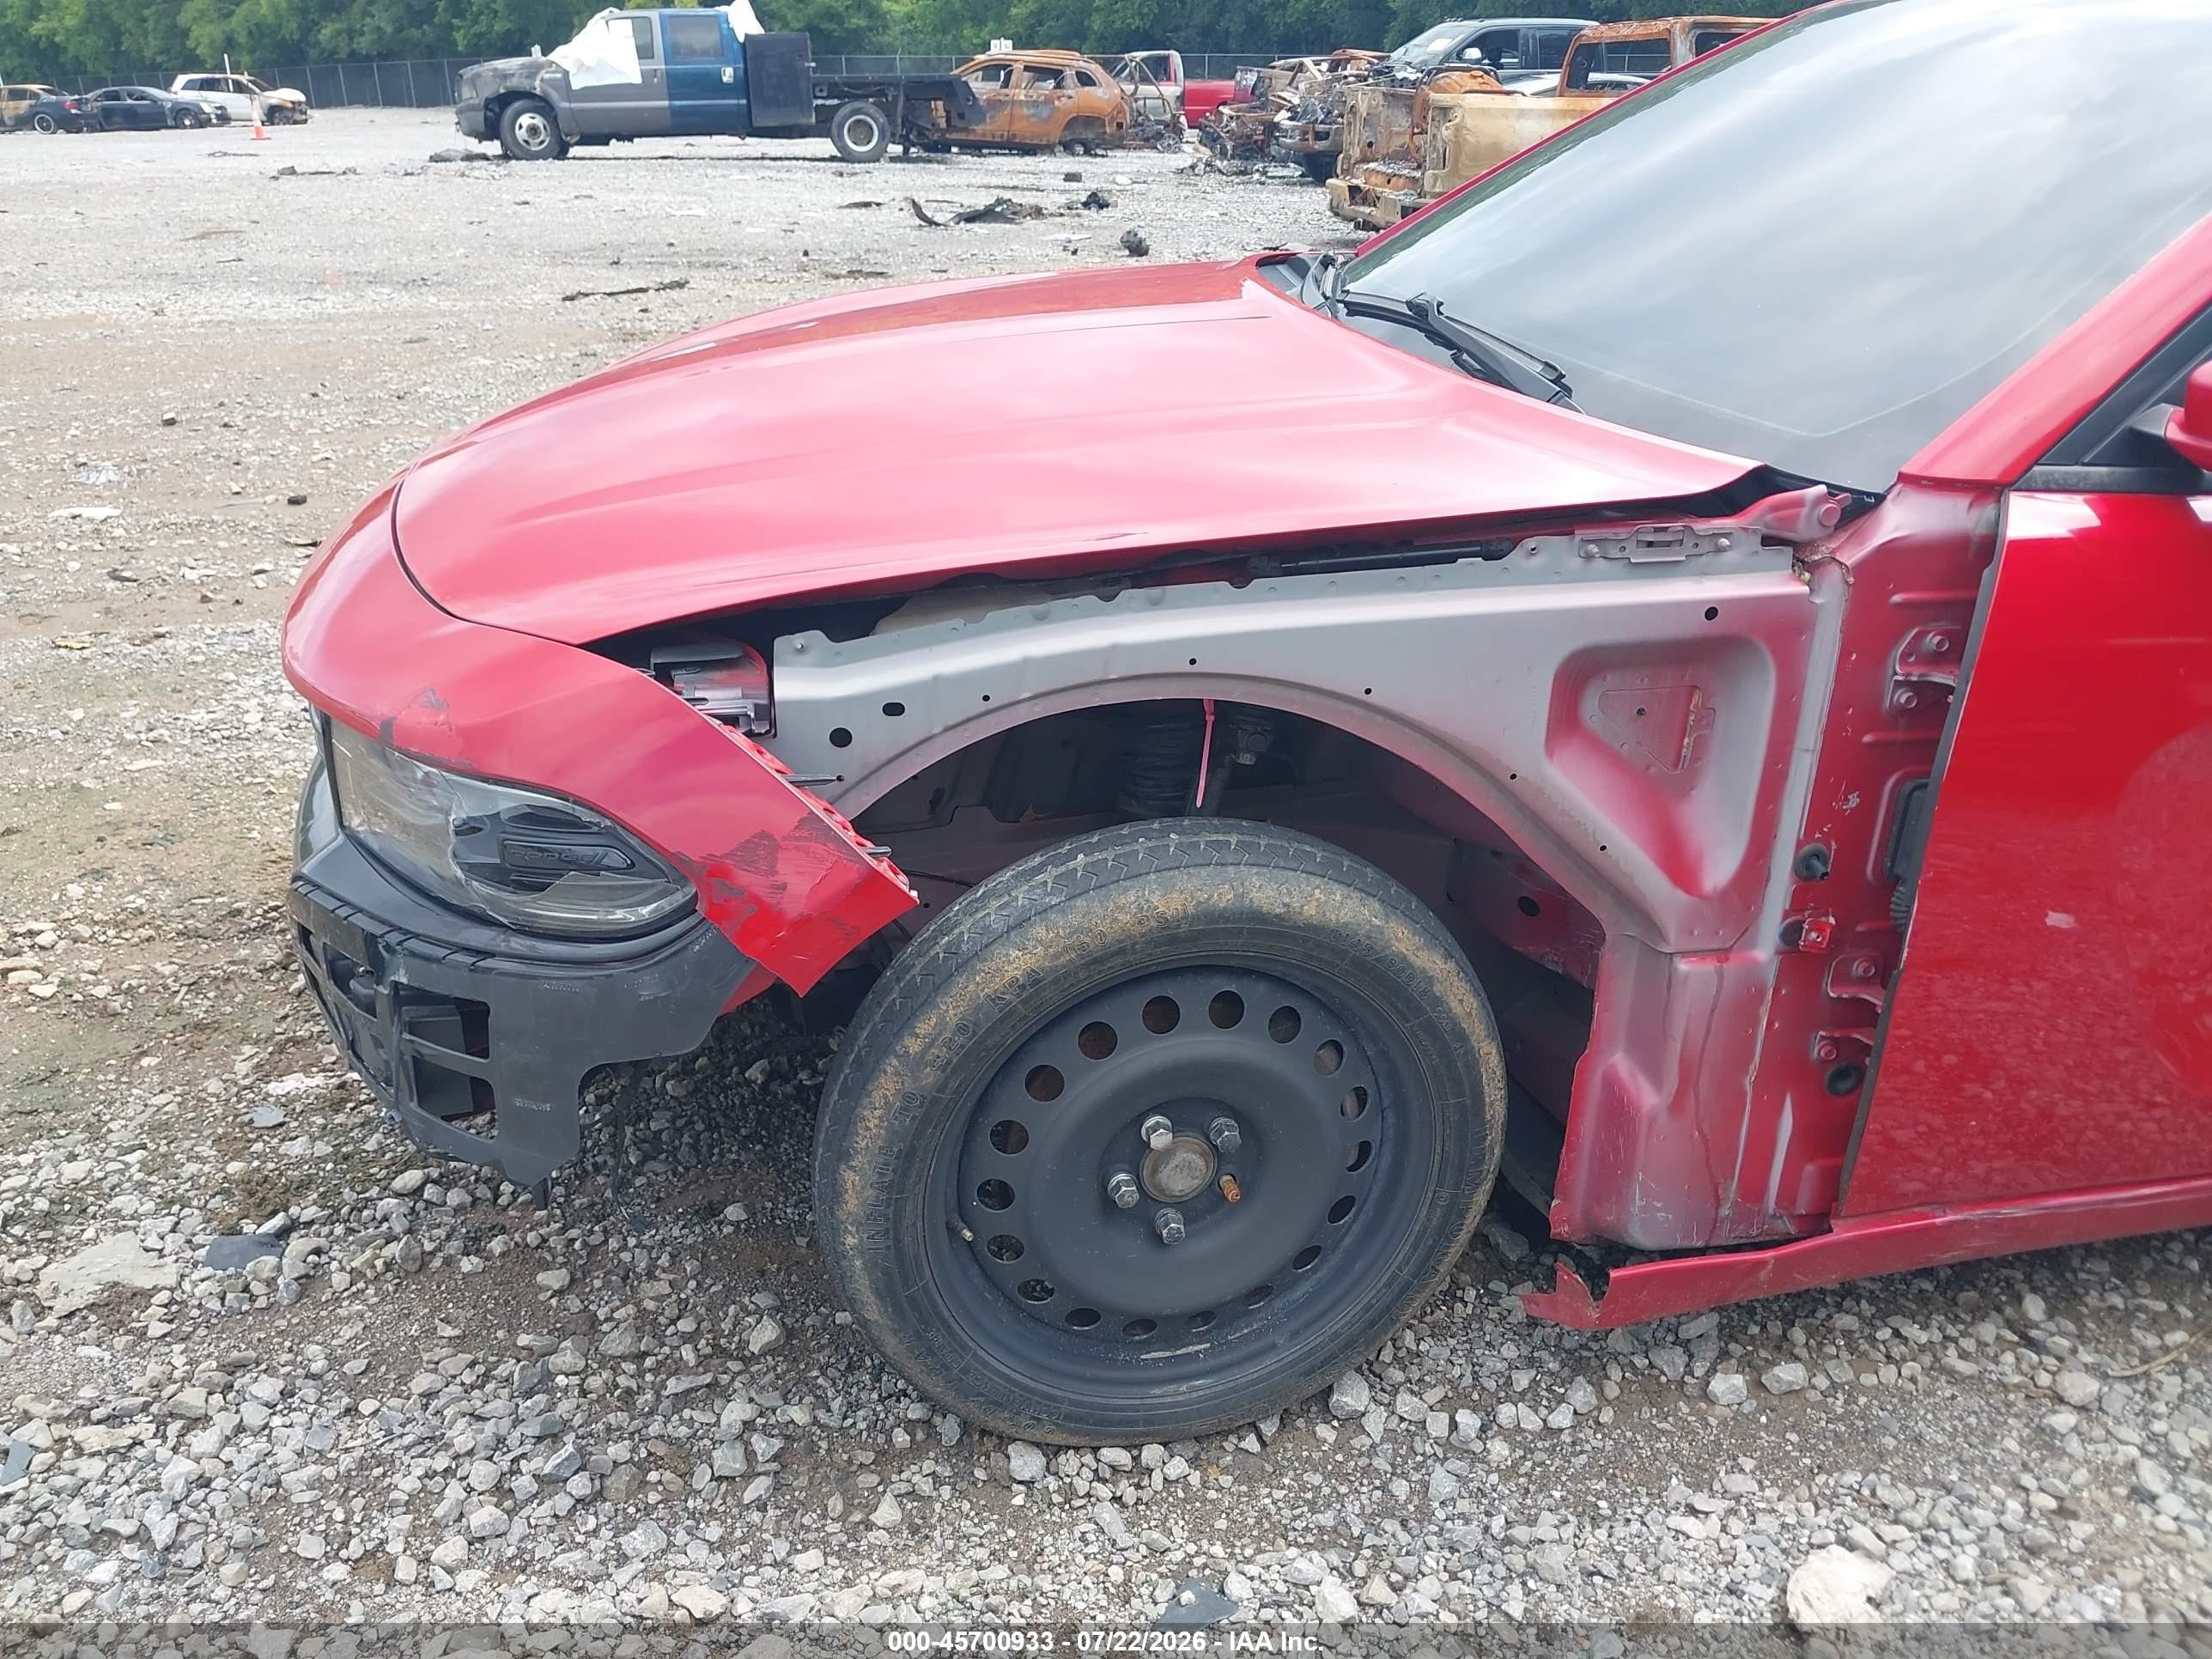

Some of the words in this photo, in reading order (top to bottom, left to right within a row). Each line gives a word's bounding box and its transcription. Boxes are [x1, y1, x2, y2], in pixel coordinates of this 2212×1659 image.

[511, 850, 593, 864] DODGE
[1330, 928, 1430, 999] T145/80D18
[867, 1146, 898, 1253] INFLATE
[891, 1091, 921, 1123] TO
[928, 1020, 973, 1071] 420
[983, 963, 1045, 1012] KPA
[1062, 927, 1109, 962] (60
[1135, 904, 1188, 935] PSI)
